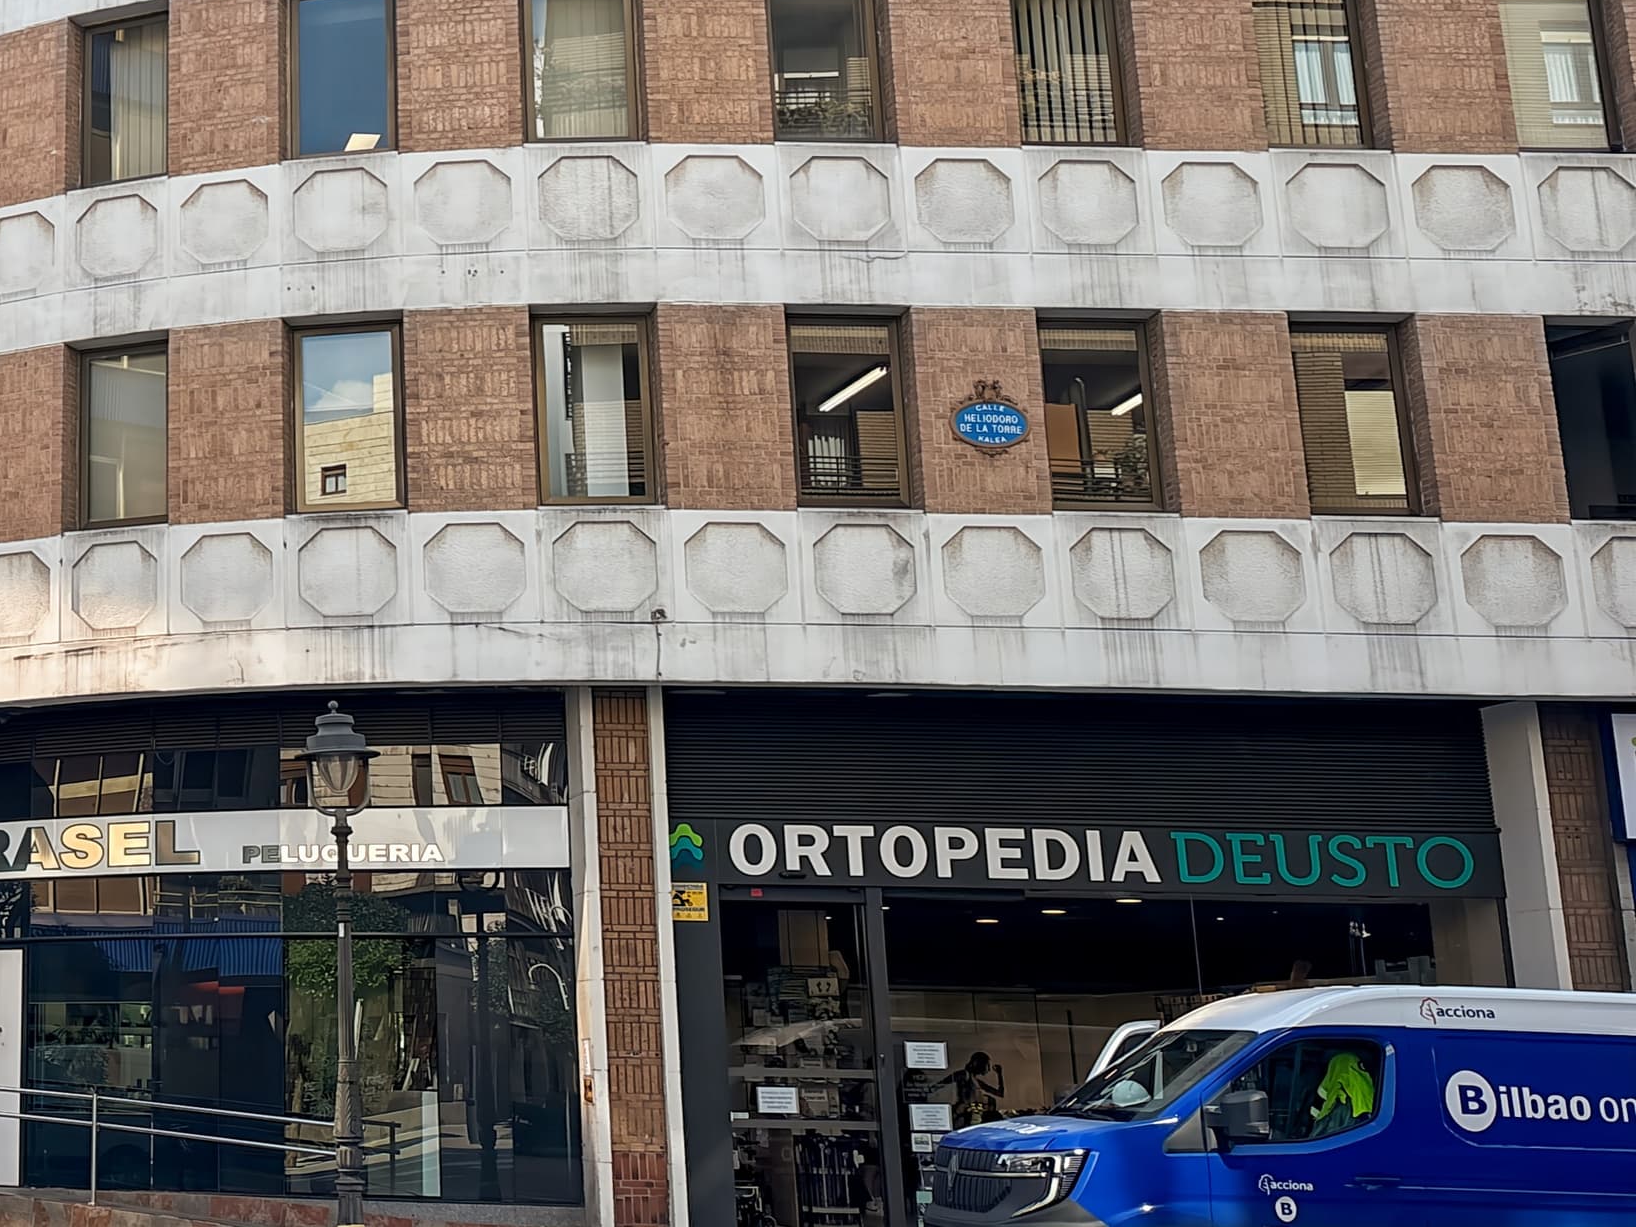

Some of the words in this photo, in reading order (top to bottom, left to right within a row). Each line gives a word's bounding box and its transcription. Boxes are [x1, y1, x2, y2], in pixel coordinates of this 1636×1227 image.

[975, 403, 1005, 412] CALLE
[964, 413, 1019, 424] HELIODORO
[959, 423, 973, 433] DE
[975, 424, 989, 433] LA
[992, 424, 1024, 435] TORRE
[977, 435, 1008, 444] KALEA
[242, 843, 445, 864] PELUQUERIA
[728, 823, 1162, 884] ORTOPEDIA
[1170, 831, 1475, 889] DEUSTO
[1436, 1005, 1496, 1020] acciona
[1452, 1080, 1592, 1124] Bilbao
[1270, 1180, 1314, 1191] acciona
[1280, 1203, 1293, 1216] B
